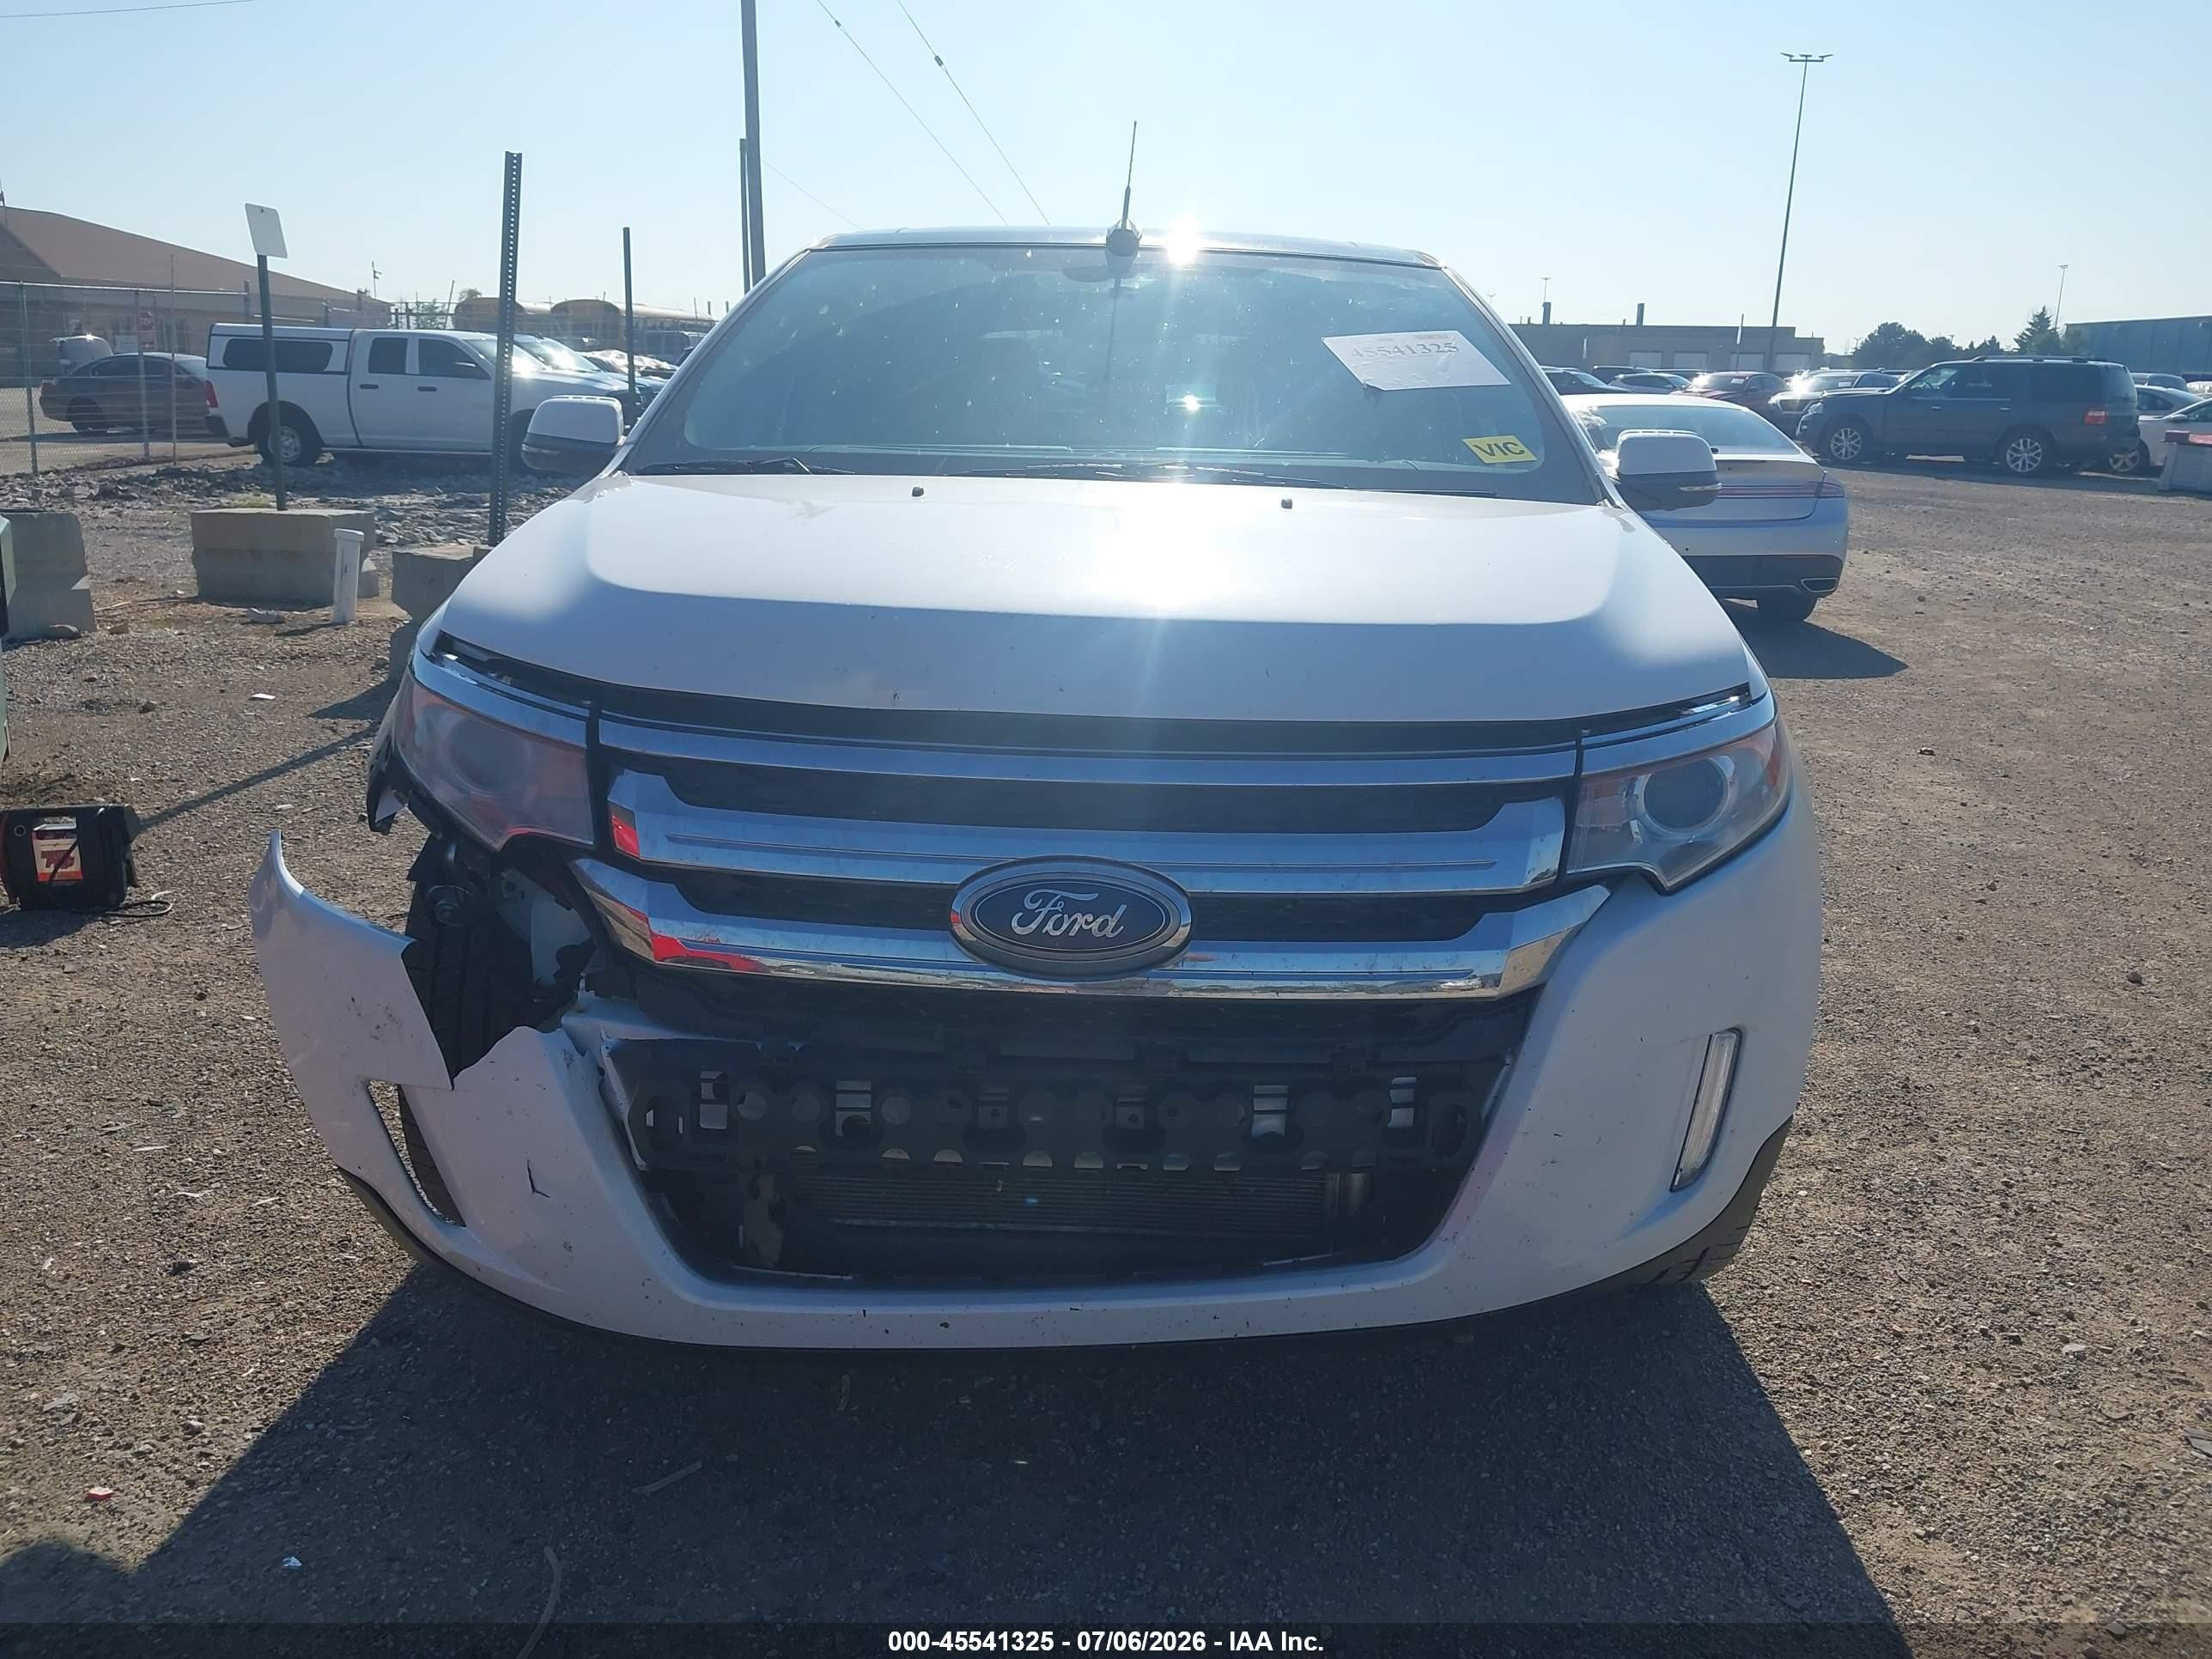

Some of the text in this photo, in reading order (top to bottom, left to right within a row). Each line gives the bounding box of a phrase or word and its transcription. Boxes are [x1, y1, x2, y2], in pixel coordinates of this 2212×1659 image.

[1351, 343, 1460, 357] 45541325
[1471, 441, 1525, 457] VIC
[1011, 889, 1127, 938] Ford
